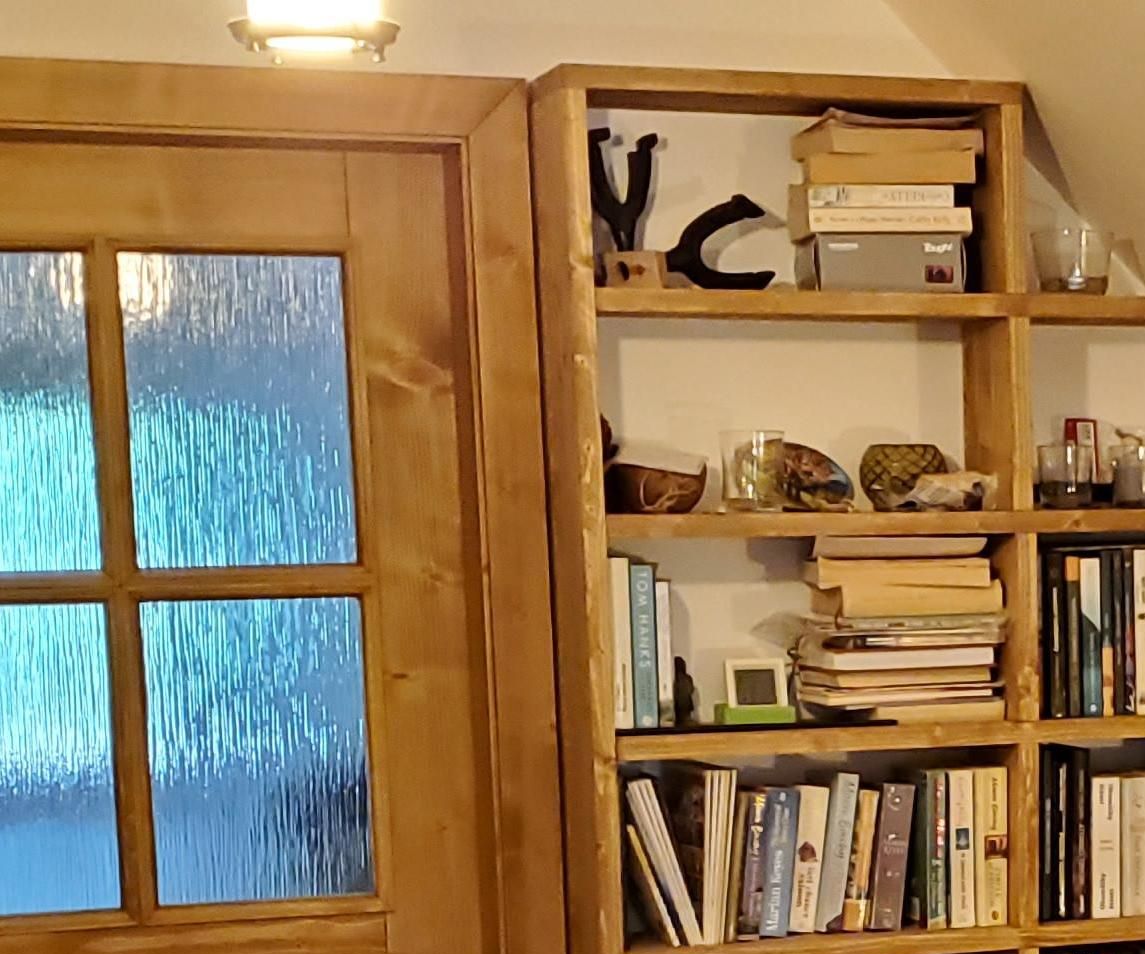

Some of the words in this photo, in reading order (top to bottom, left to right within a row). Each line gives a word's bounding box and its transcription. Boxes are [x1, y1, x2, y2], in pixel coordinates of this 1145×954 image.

[636, 570, 651, 606] TOM
[637, 613, 653, 668] HANKS
[768, 848, 784, 880] Keyes
[764, 880, 783, 931] Marian
